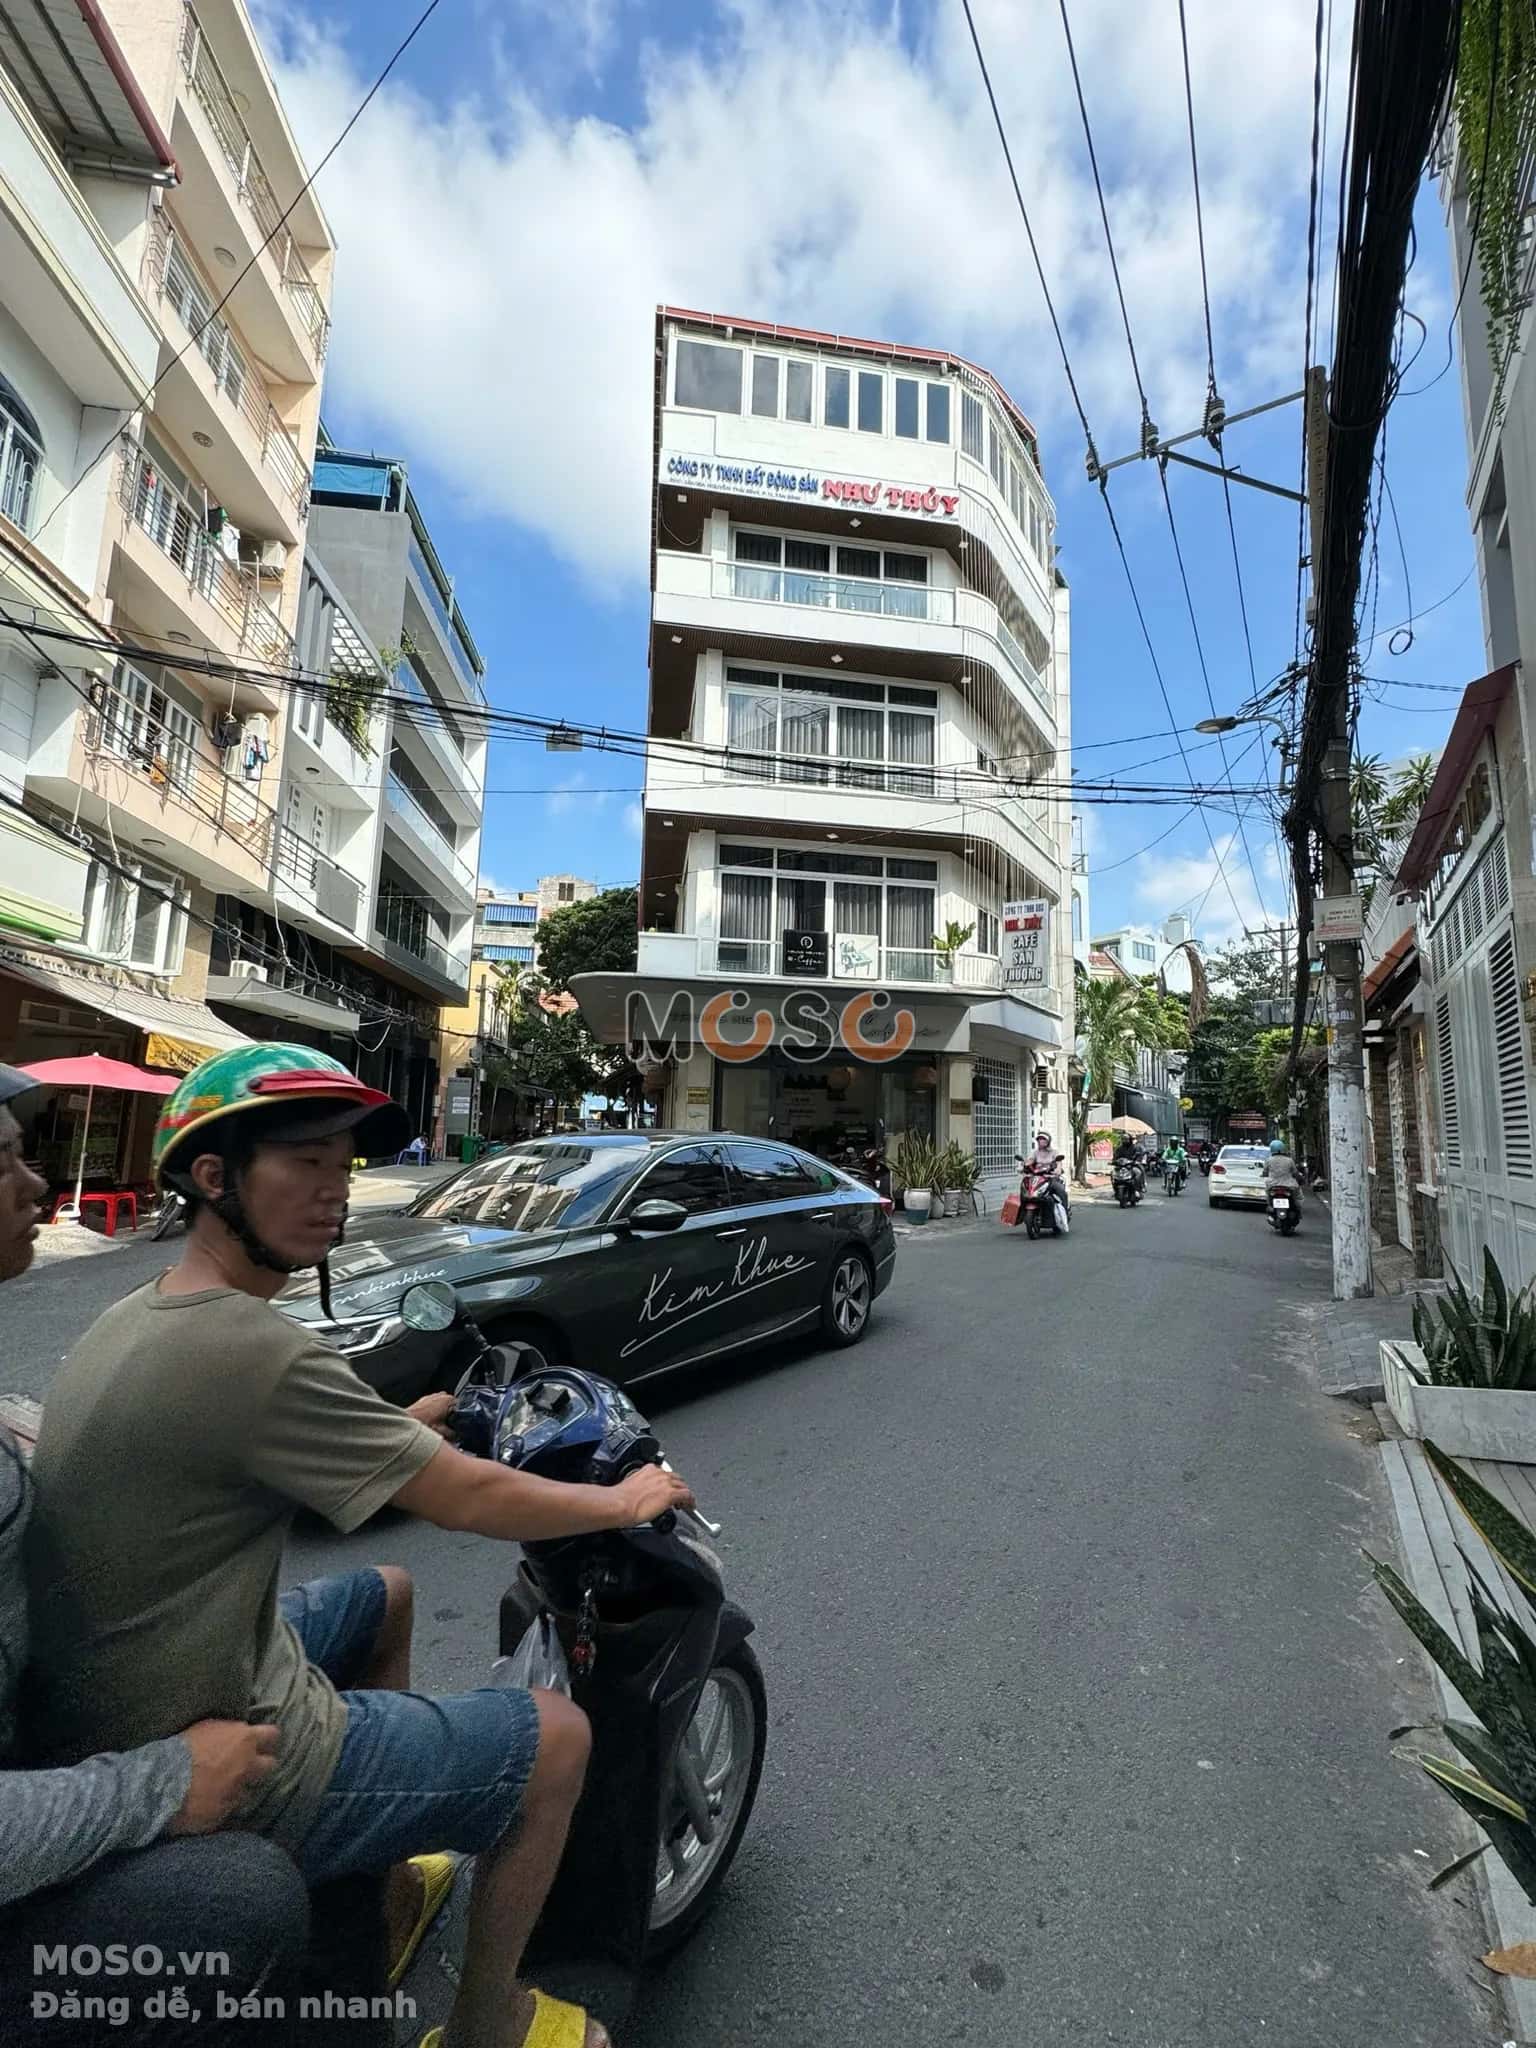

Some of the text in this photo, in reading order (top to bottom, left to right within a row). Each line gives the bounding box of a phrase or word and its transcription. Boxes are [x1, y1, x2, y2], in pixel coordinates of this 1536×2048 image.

[668, 456, 698, 476] CÔNG
[700, 463, 714, 479] TY
[716, 465, 744, 483] TNHH
[822, 479, 882, 505] NHƯ
[638, 1237, 808, 1323] Kim Khue
